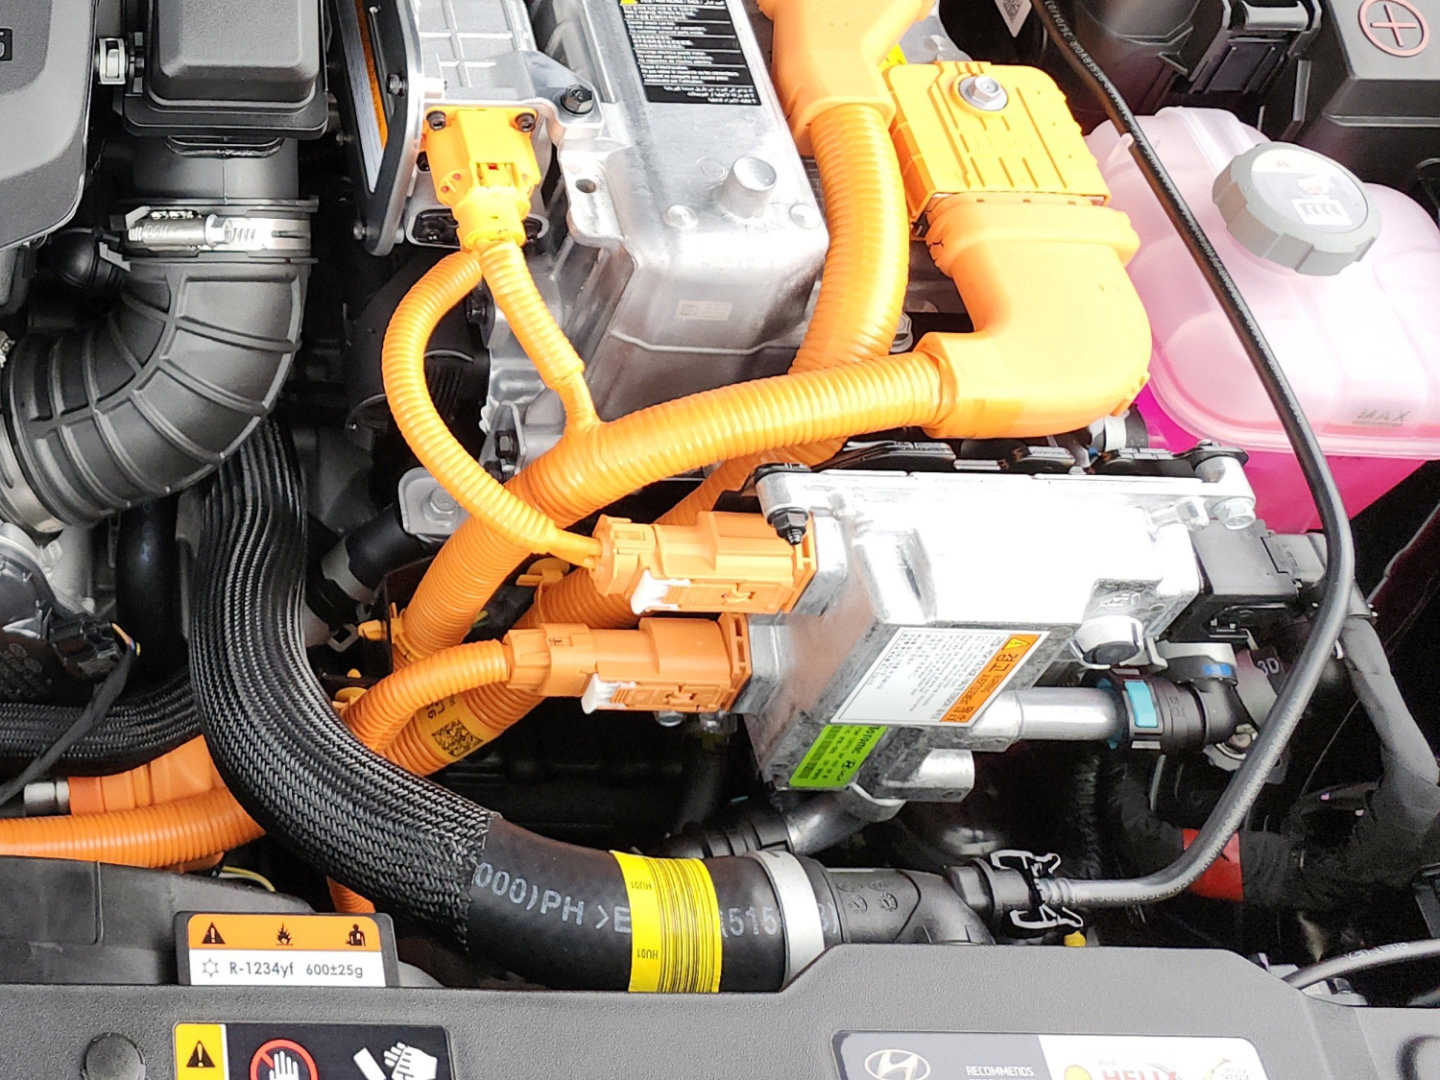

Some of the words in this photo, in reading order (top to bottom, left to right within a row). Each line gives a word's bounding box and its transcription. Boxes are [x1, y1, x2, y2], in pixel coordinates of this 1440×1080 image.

[229, 961, 294, 978] R-1234yf
[306, 964, 363, 978] 600±25g
[965, 1065, 1034, 1077] RECOMMENDS
